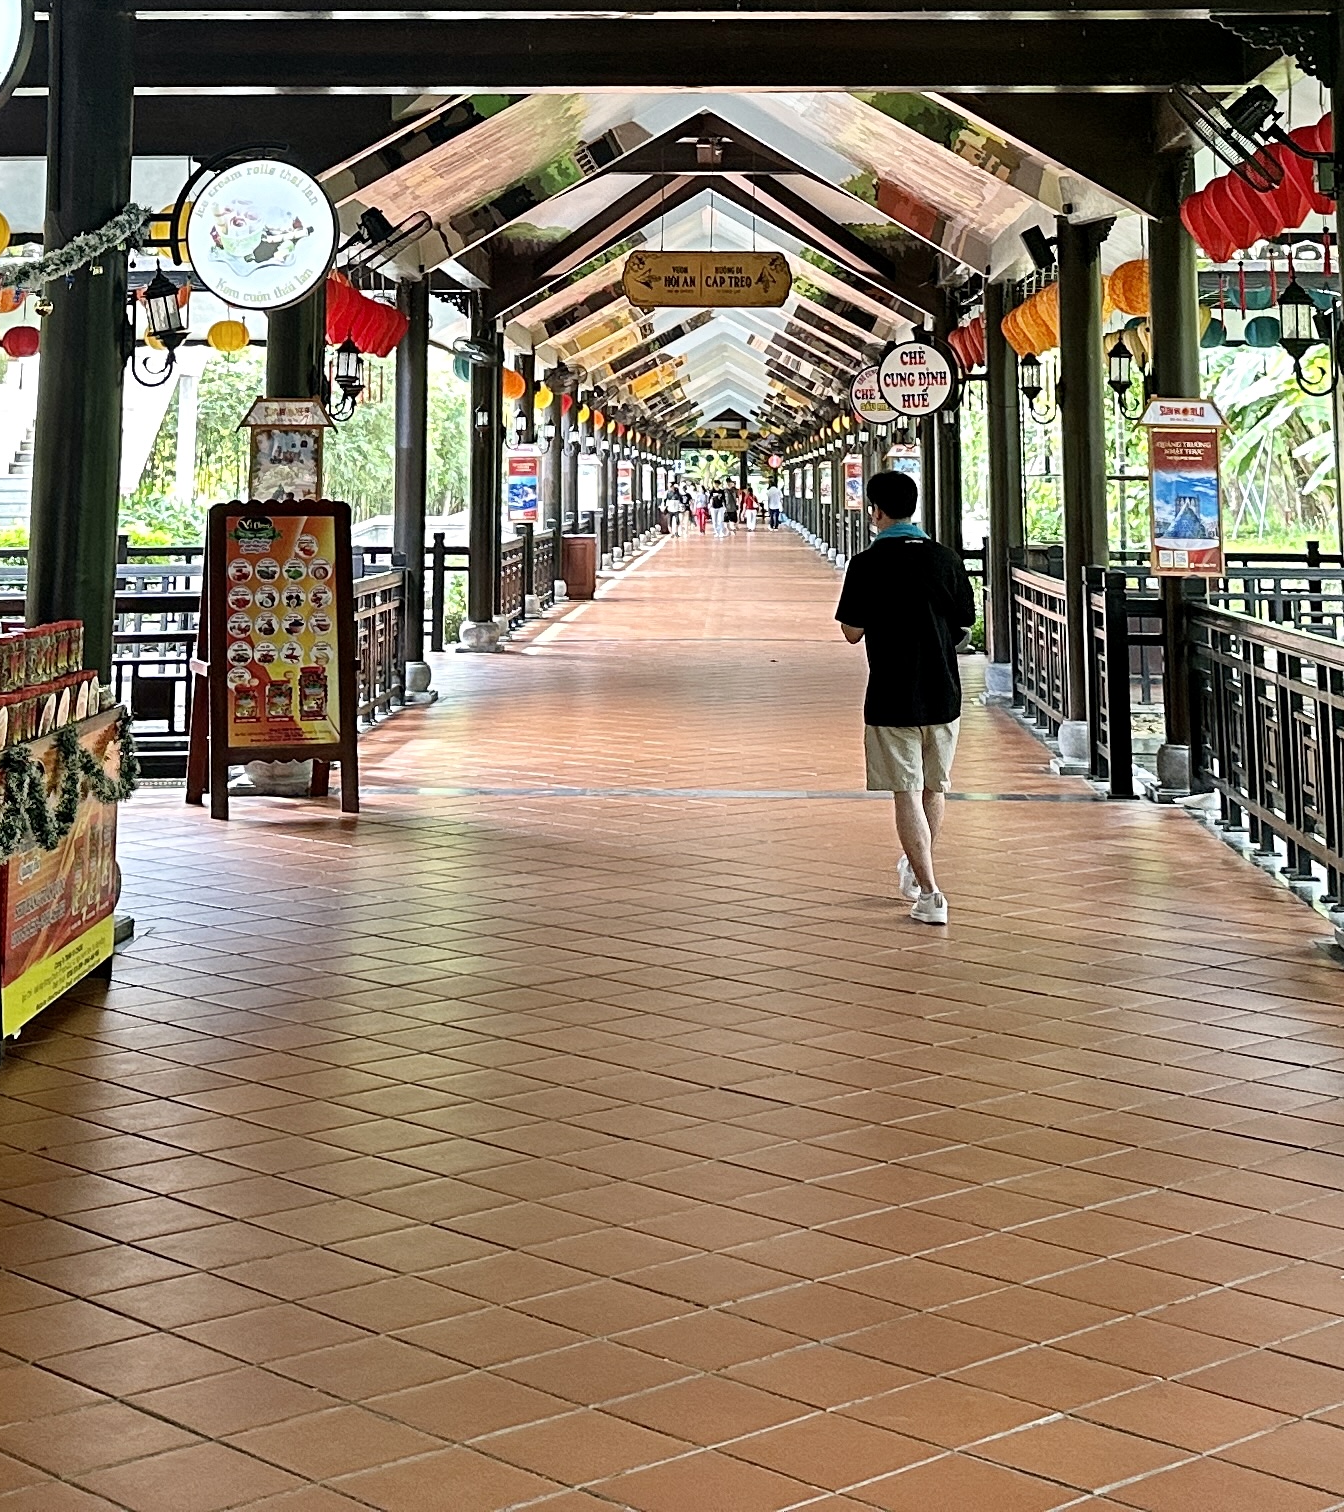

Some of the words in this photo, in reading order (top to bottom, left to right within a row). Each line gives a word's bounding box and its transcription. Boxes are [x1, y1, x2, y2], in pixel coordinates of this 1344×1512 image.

[208, 170, 242, 198] cream
[246, 164, 276, 176] rolls
[302, 184, 319, 206] lan
[216, 277, 240, 300] Kem
[243, 290, 271, 304] cuộn
[273, 282, 297, 302] thái
[295, 267, 314, 288] lan
[682, 275, 696, 288] AN
[900, 346, 926, 366] CHÈ
[883, 372, 915, 388] CUNG
[918, 367, 947, 387] ĐÌNH
[855, 385, 876, 400] CHÈ
[901, 386, 930, 409] HUẾ
